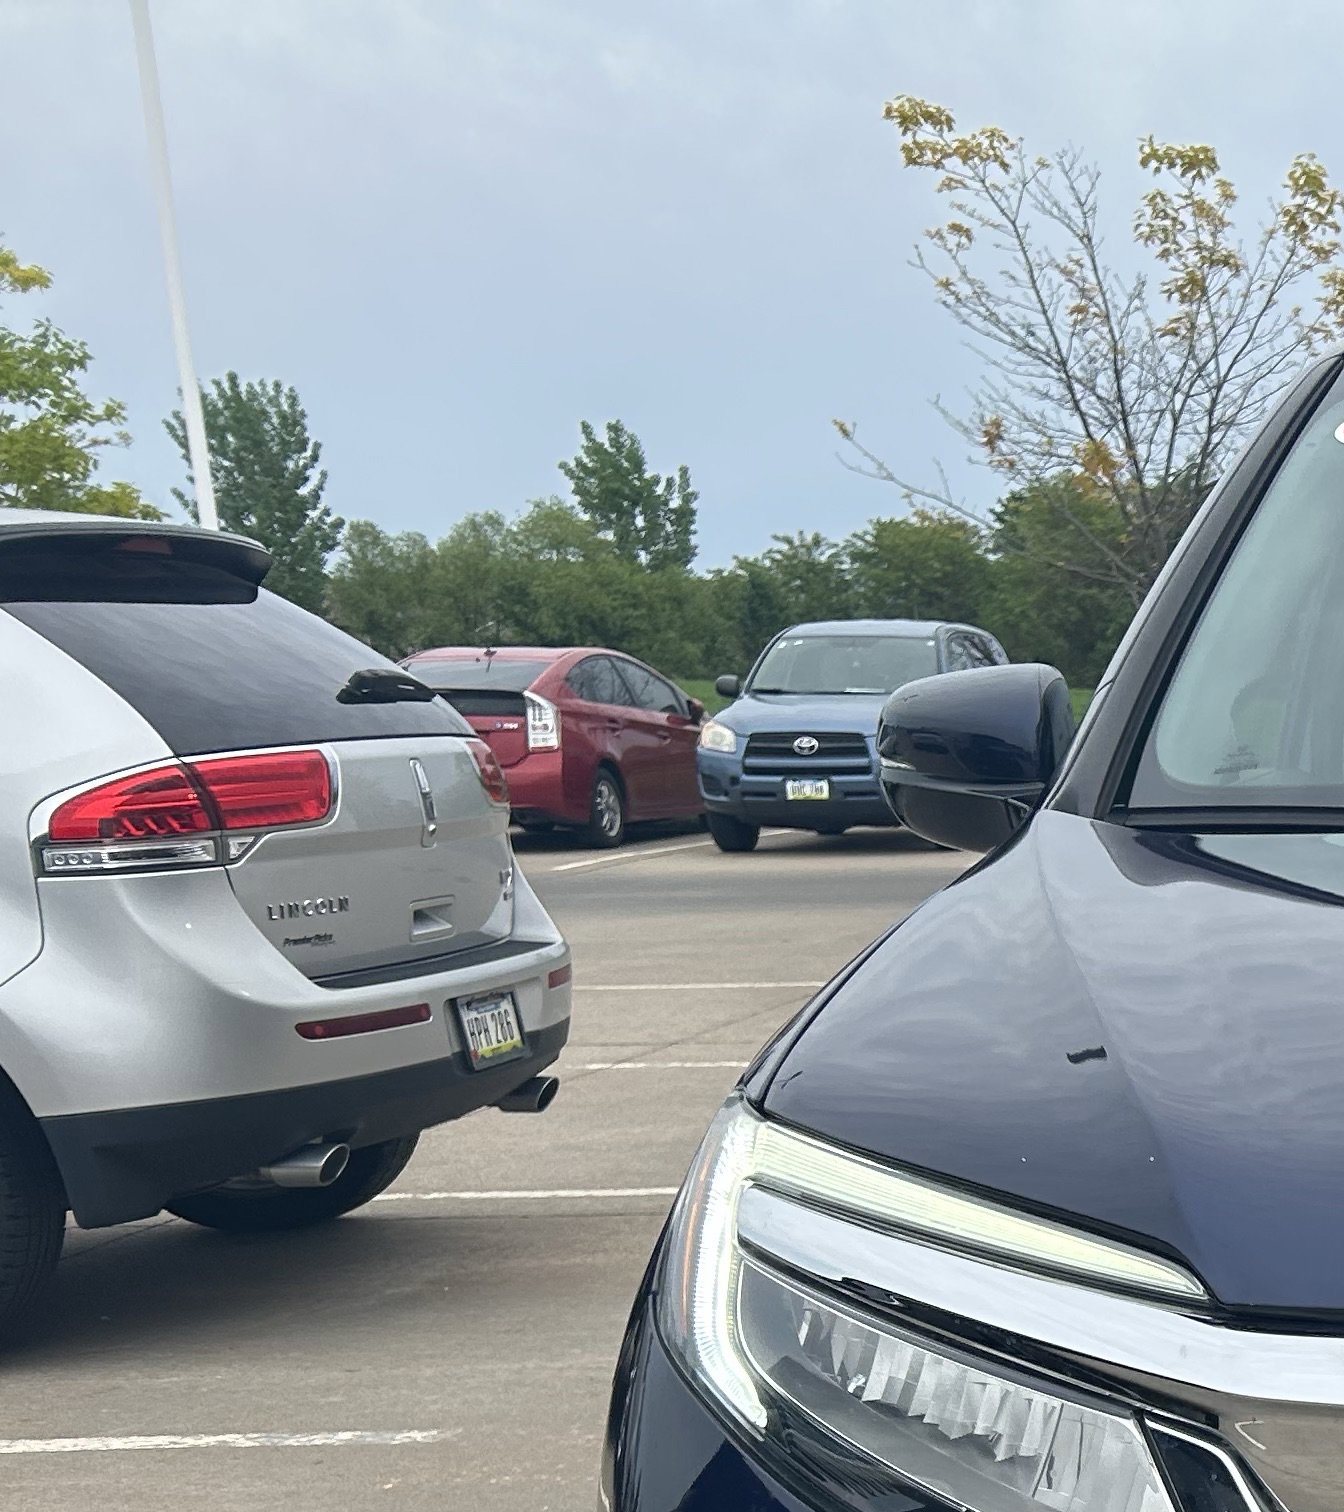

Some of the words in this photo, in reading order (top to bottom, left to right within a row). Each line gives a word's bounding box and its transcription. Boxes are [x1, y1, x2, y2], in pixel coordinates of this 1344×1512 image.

[267, 896, 350, 921] LINCOLN
[467, 1014, 493, 1051] HPH
[491, 1009, 515, 1043] 286
